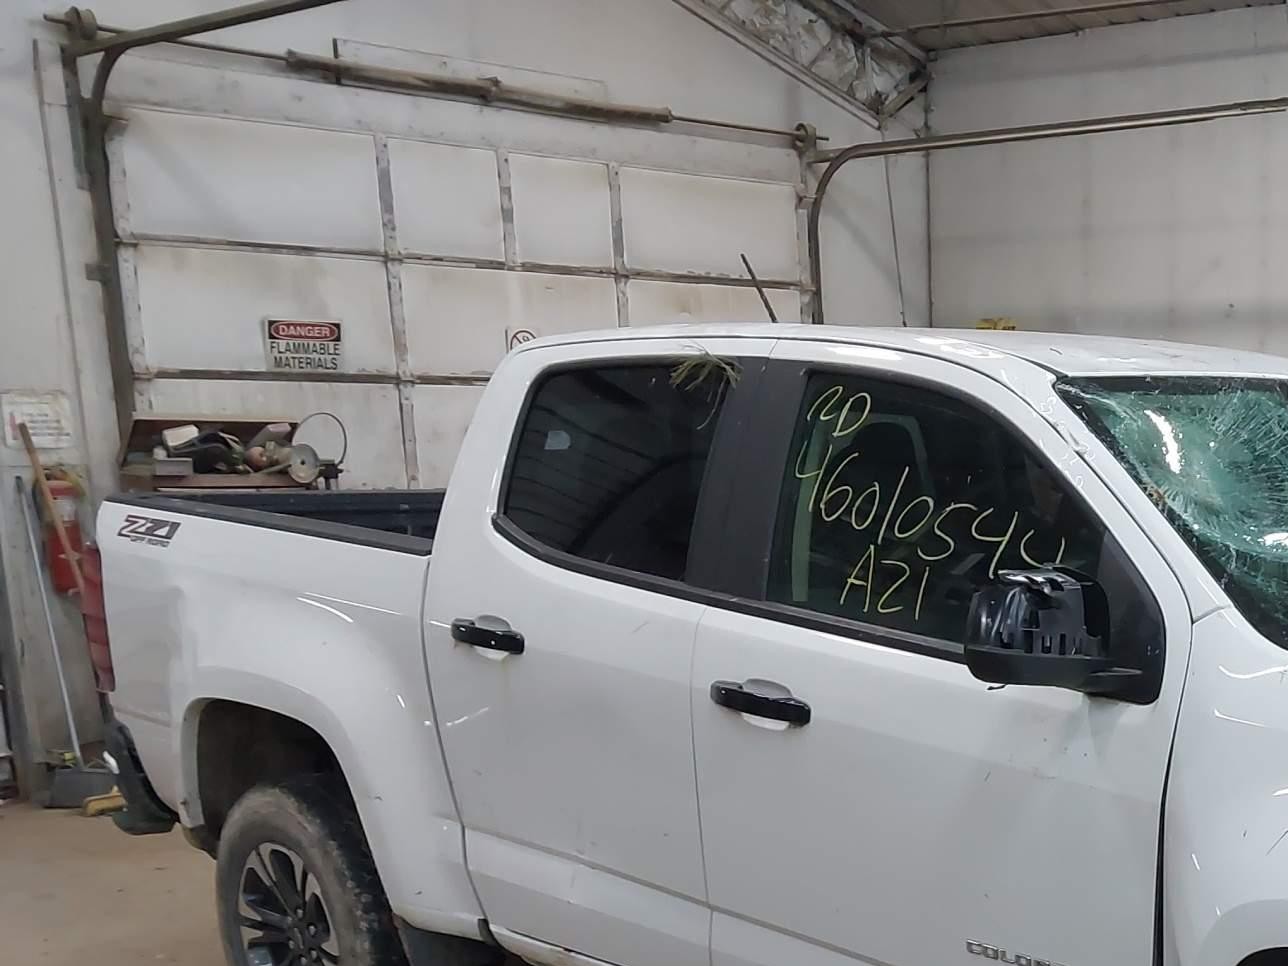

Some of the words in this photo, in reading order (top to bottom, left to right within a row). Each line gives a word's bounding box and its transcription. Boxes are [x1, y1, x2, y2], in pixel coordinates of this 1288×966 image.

[278, 325, 331, 337] DANGER
[269, 341, 341, 356] FLAMMABLE
[274, 356, 338, 370] MATERIALS
[840, 545, 929, 620] A21
